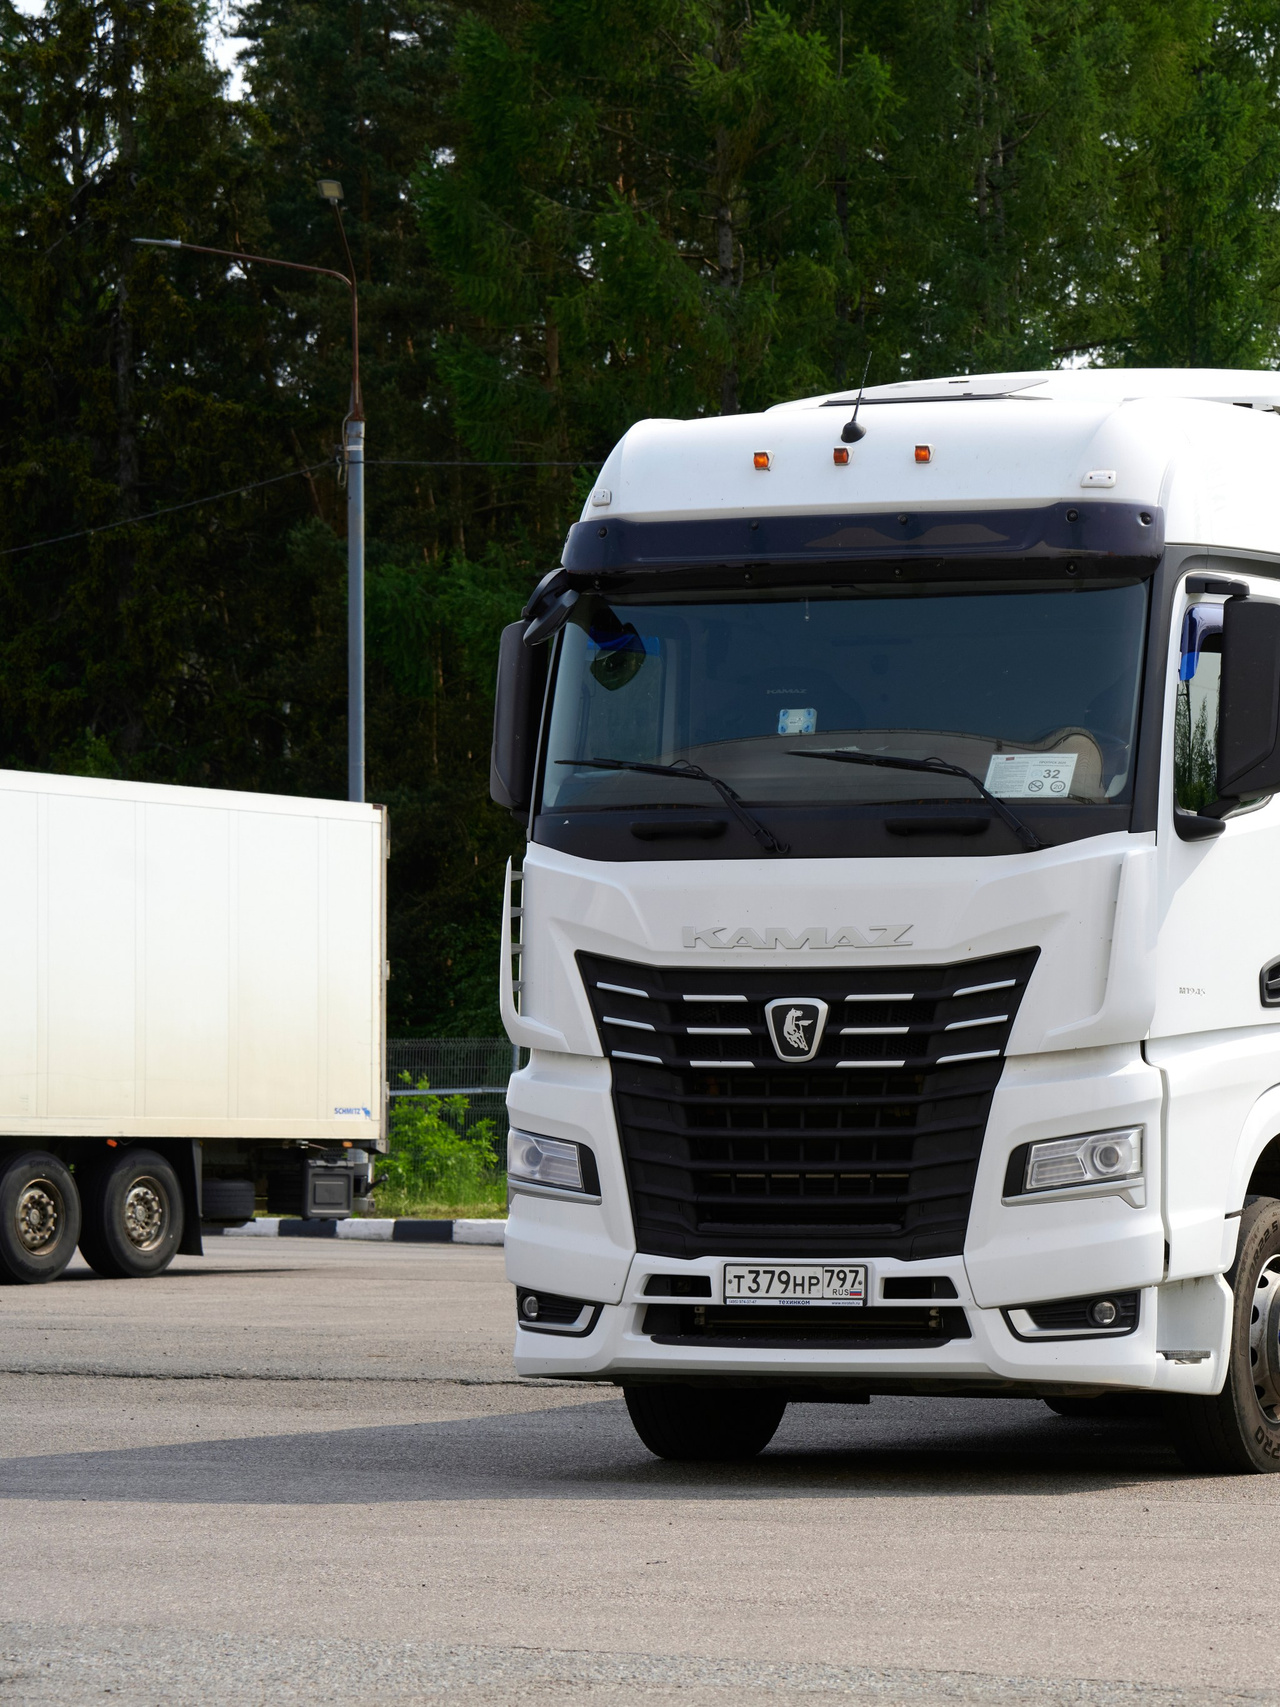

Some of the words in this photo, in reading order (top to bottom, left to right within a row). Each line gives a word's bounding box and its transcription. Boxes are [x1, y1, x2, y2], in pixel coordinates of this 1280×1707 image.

[1043, 769, 1061, 779] 32
[682, 924, 914, 950] KAMAZ
[334, 1107, 361, 1115] SCHMITZ
[824, 1269, 860, 1288] 797
